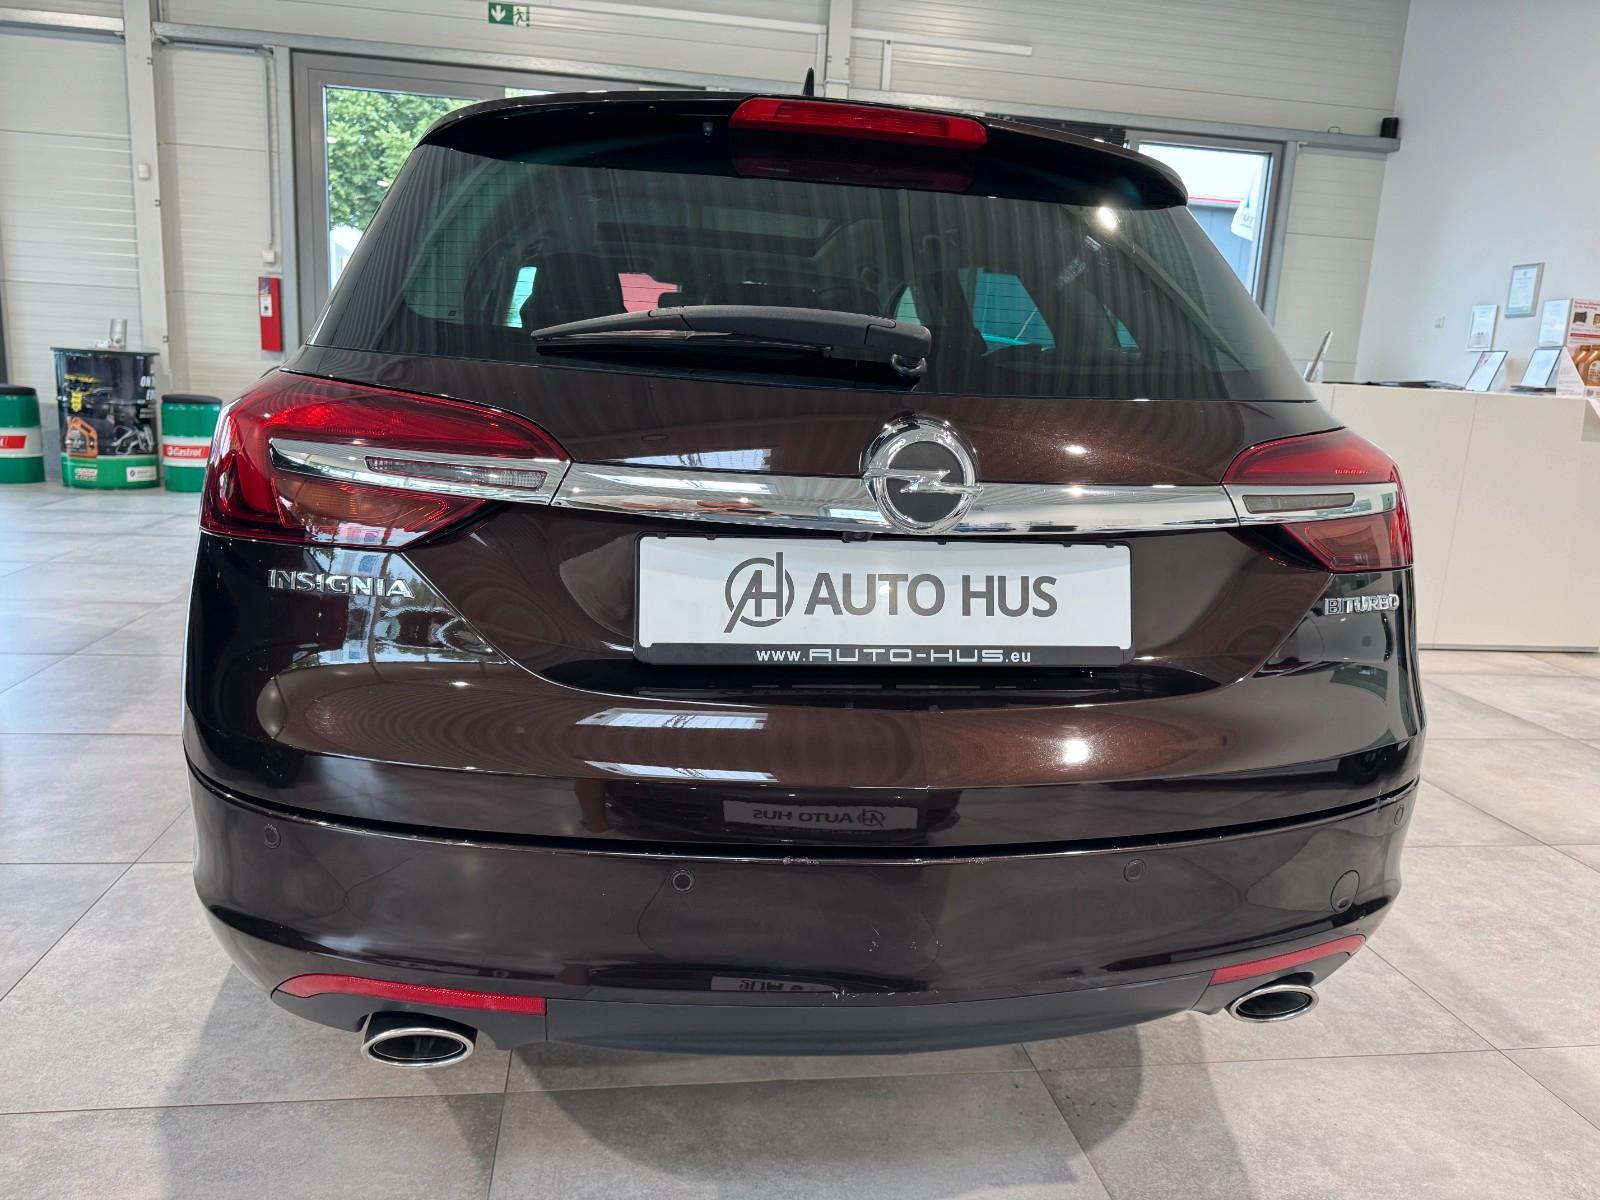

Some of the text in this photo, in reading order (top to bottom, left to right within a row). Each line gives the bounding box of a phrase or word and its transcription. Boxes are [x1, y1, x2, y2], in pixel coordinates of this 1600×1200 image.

[267, 569, 415, 599] INSIGNIA
[804, 572, 1058, 618] AUTO HUS
[1324, 594, 1400, 615] BITURBO
[756, 647, 1032, 664] www.AUTO-HUS.eu
